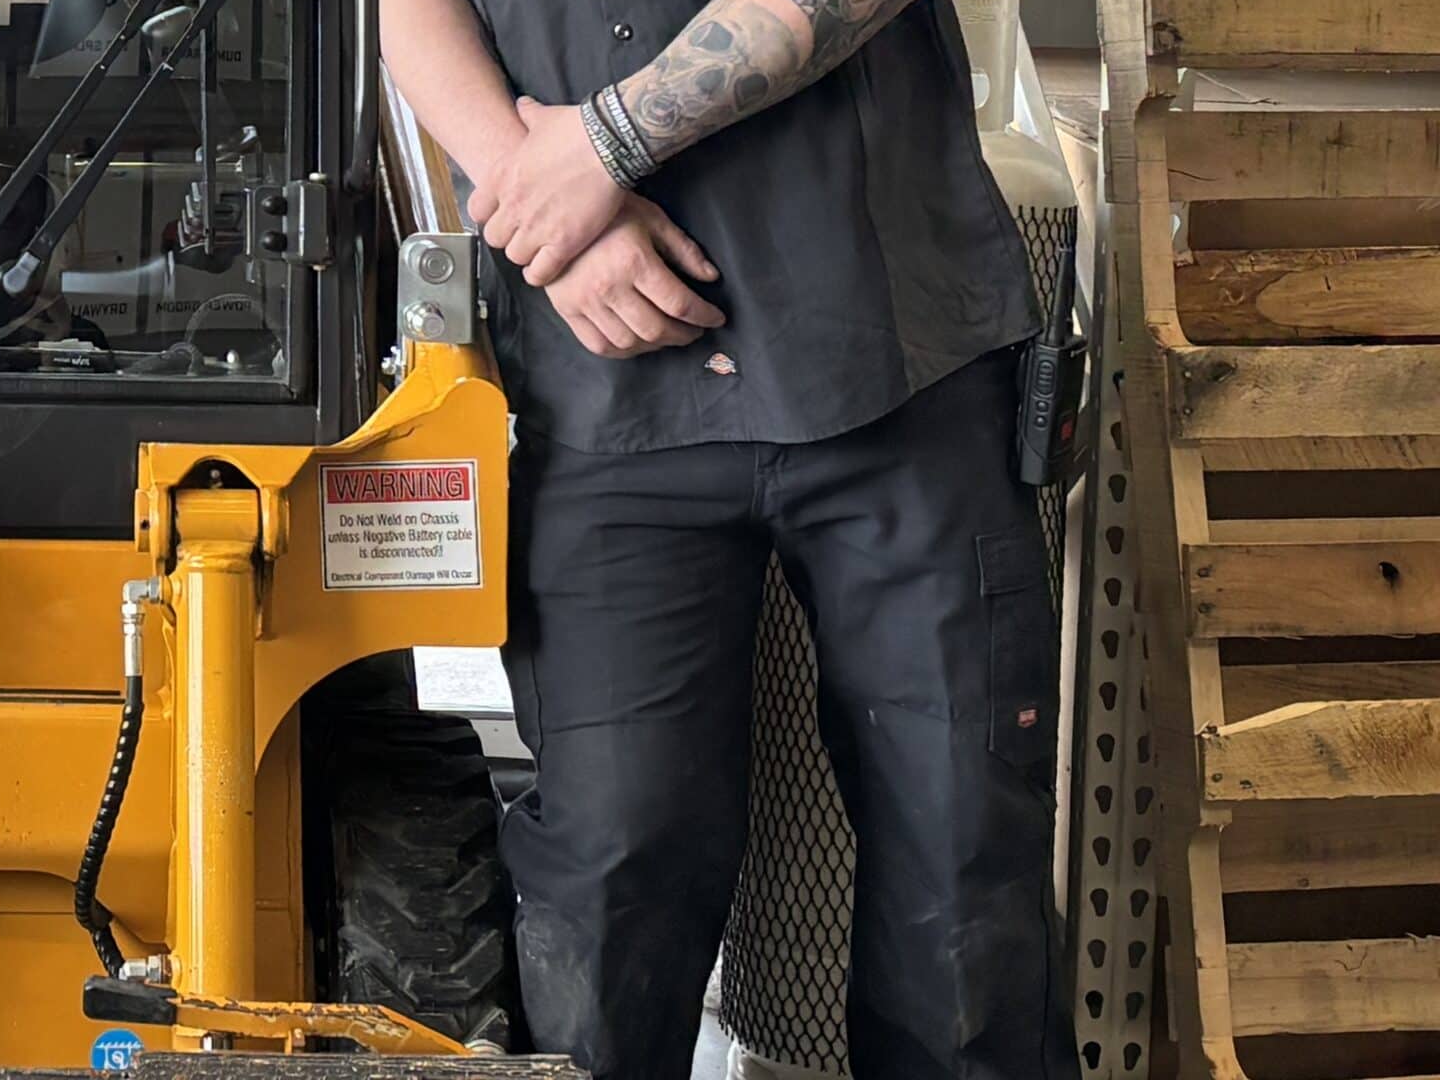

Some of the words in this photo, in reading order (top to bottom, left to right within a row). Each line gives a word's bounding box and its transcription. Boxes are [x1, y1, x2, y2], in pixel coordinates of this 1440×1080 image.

[334, 471, 463, 500] WARNING
[340, 514, 353, 527] Do
[356, 514, 374, 527] Not
[377, 514, 401, 526] Weld
[405, 517, 417, 526] on
[421, 512, 459, 525] Chassis
[328, 532, 360, 544] unless
[363, 531, 405, 545] Negative
[409, 529, 443, 545] Battery
[447, 528, 472, 541] cable
[359, 547, 367, 559] is
